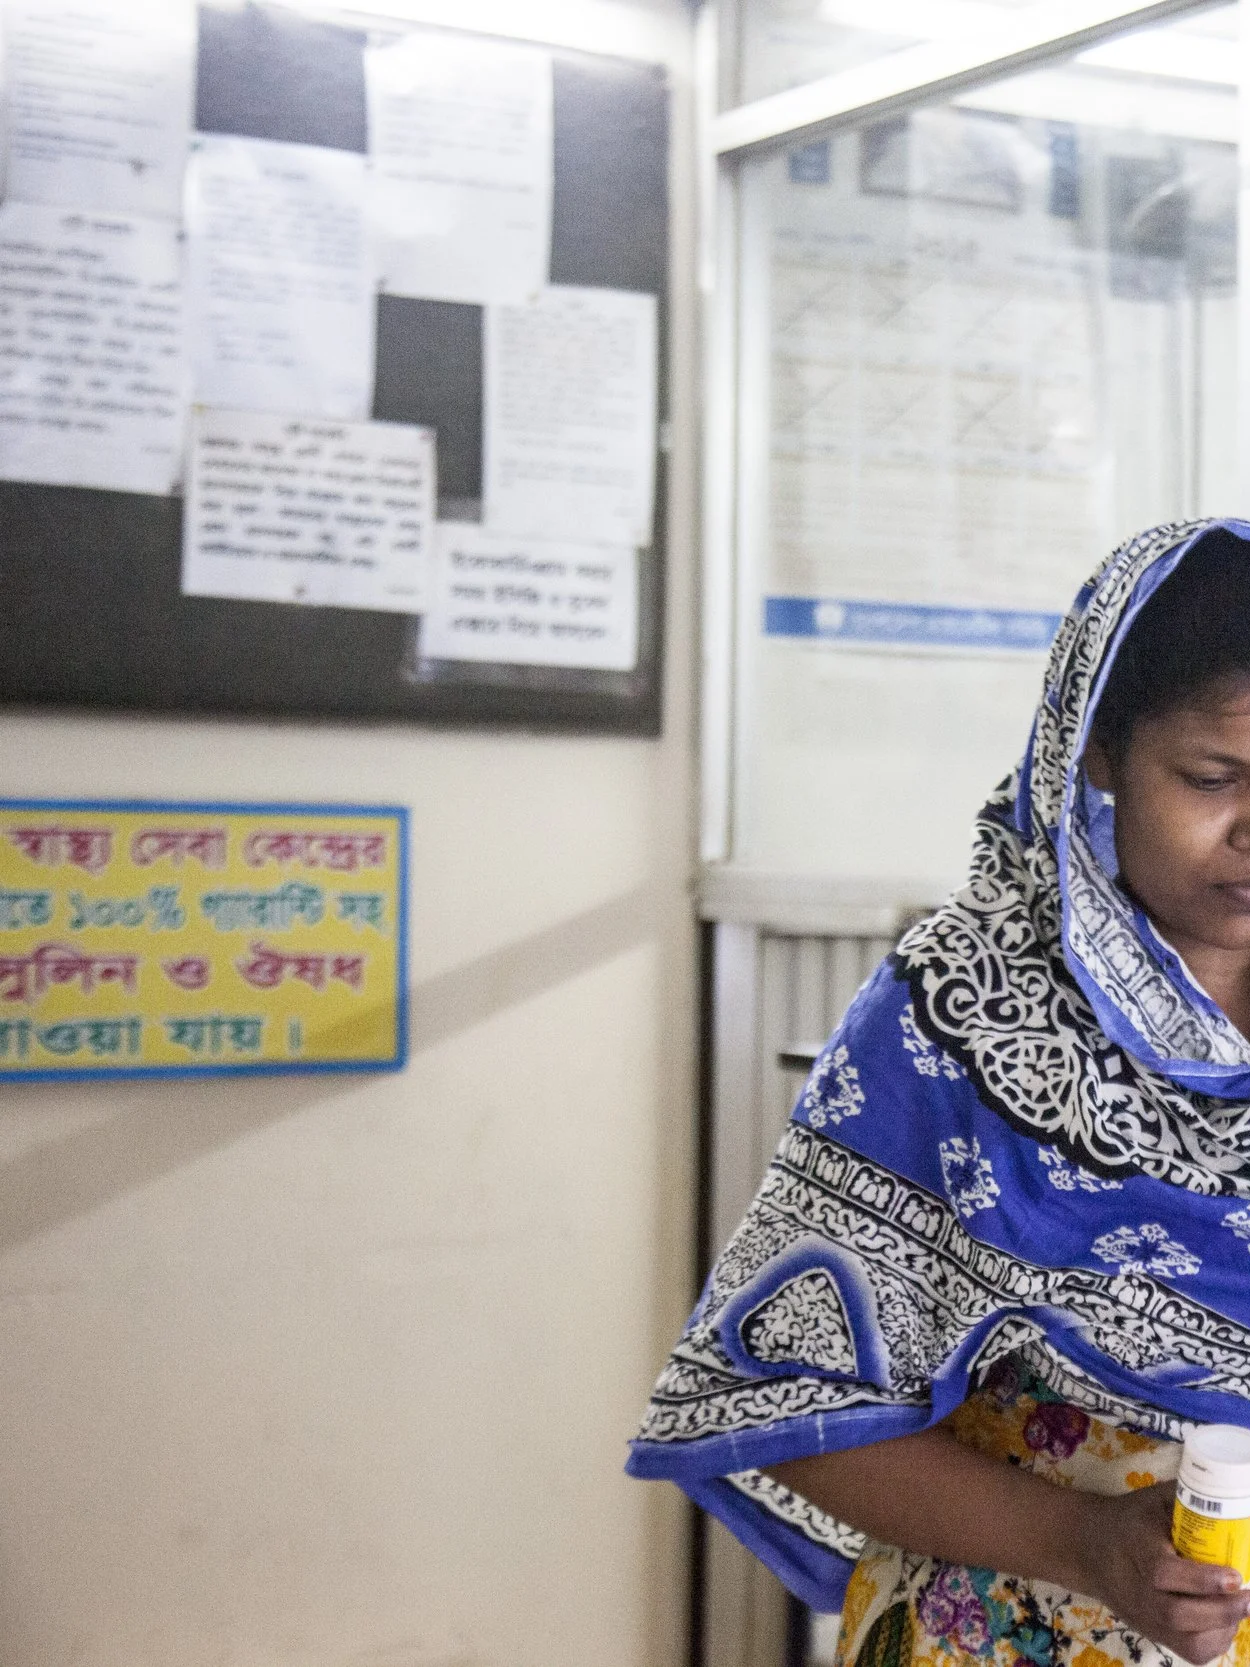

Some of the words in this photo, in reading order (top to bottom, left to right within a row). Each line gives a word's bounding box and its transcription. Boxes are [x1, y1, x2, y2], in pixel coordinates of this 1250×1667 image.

[131, 828, 229, 870] সেবা
[0, 890, 52, 930] তে
[68, 887, 186, 932] ১০০%
[0, 942, 140, 1002] সুলিন
[160, 955, 210, 990] ও
[234, 941, 366, 994] ঔষধ
